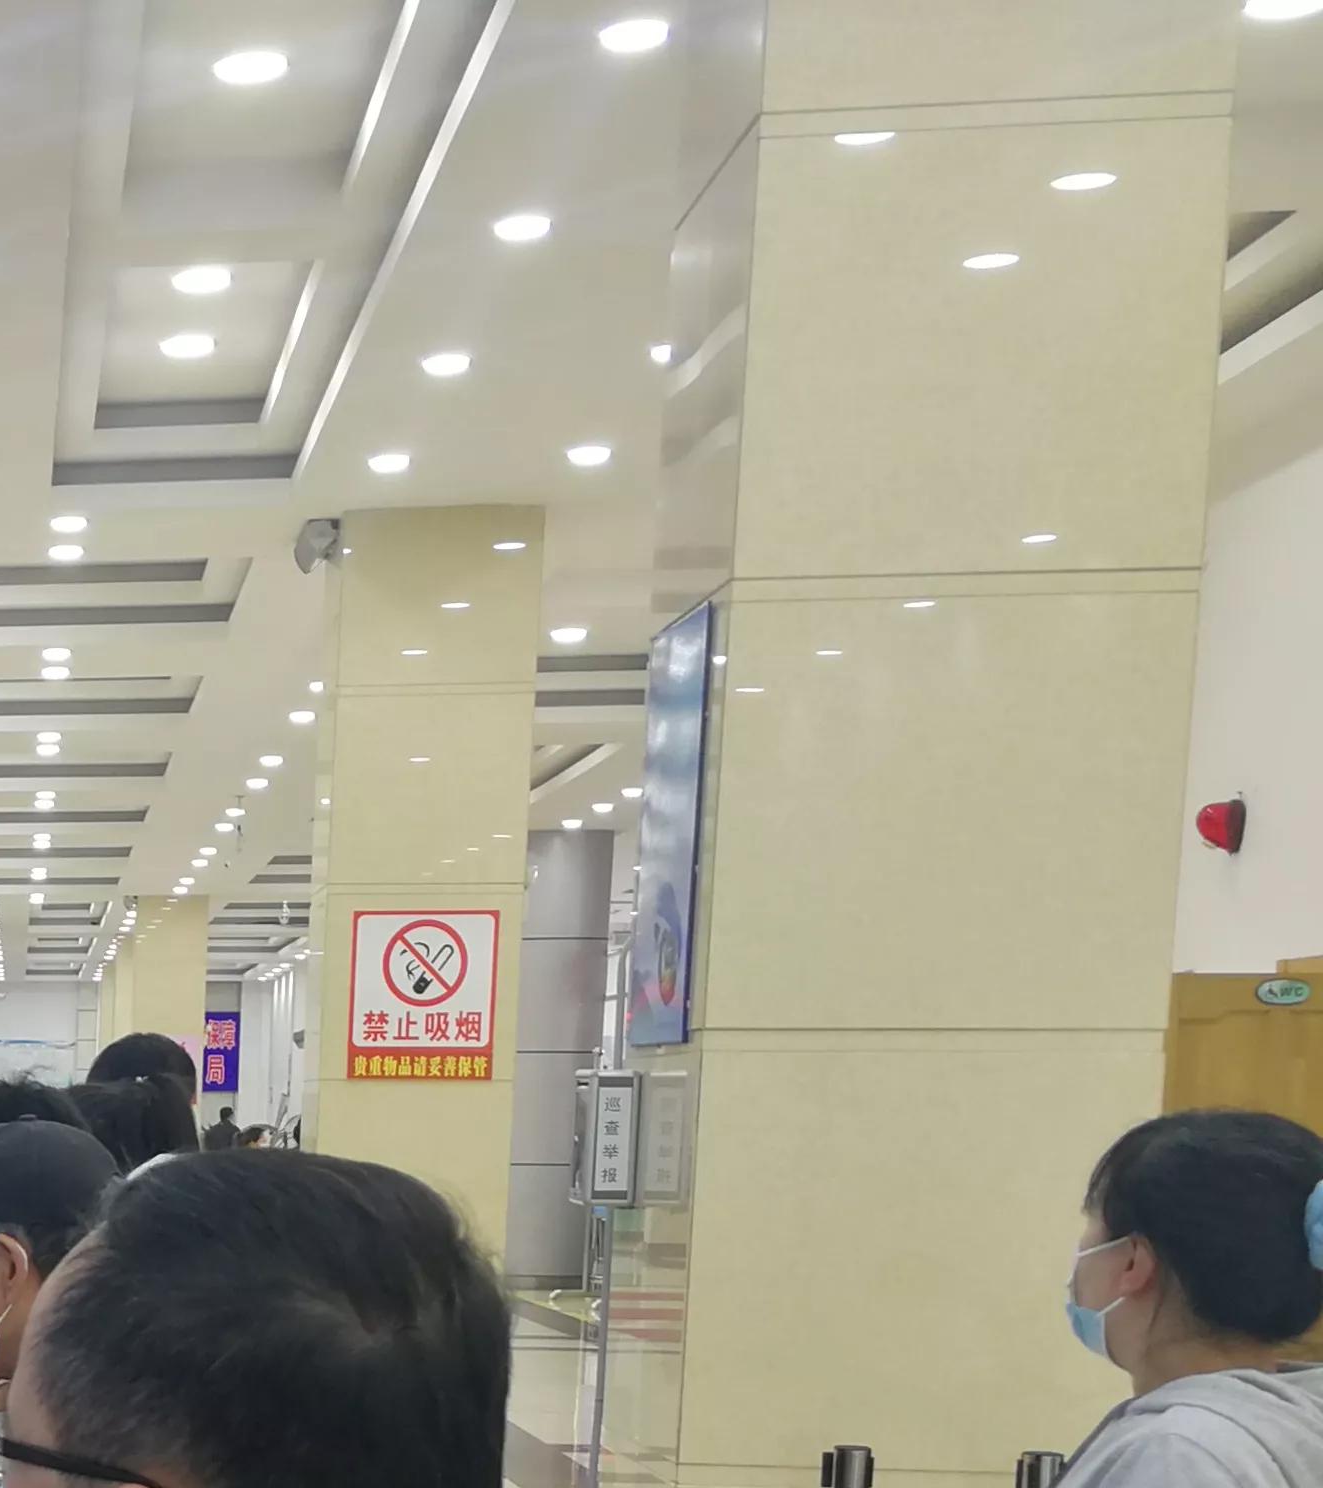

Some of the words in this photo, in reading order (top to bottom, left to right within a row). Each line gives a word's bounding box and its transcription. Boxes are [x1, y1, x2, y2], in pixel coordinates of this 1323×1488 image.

[362, 1010, 482, 1042] 禁止吸烟
[205, 1054, 225, 1085] 局
[354, 1055, 488, 1077] 贵重物品请妥善保管
[601, 1096, 621, 1183] 巡查举报
